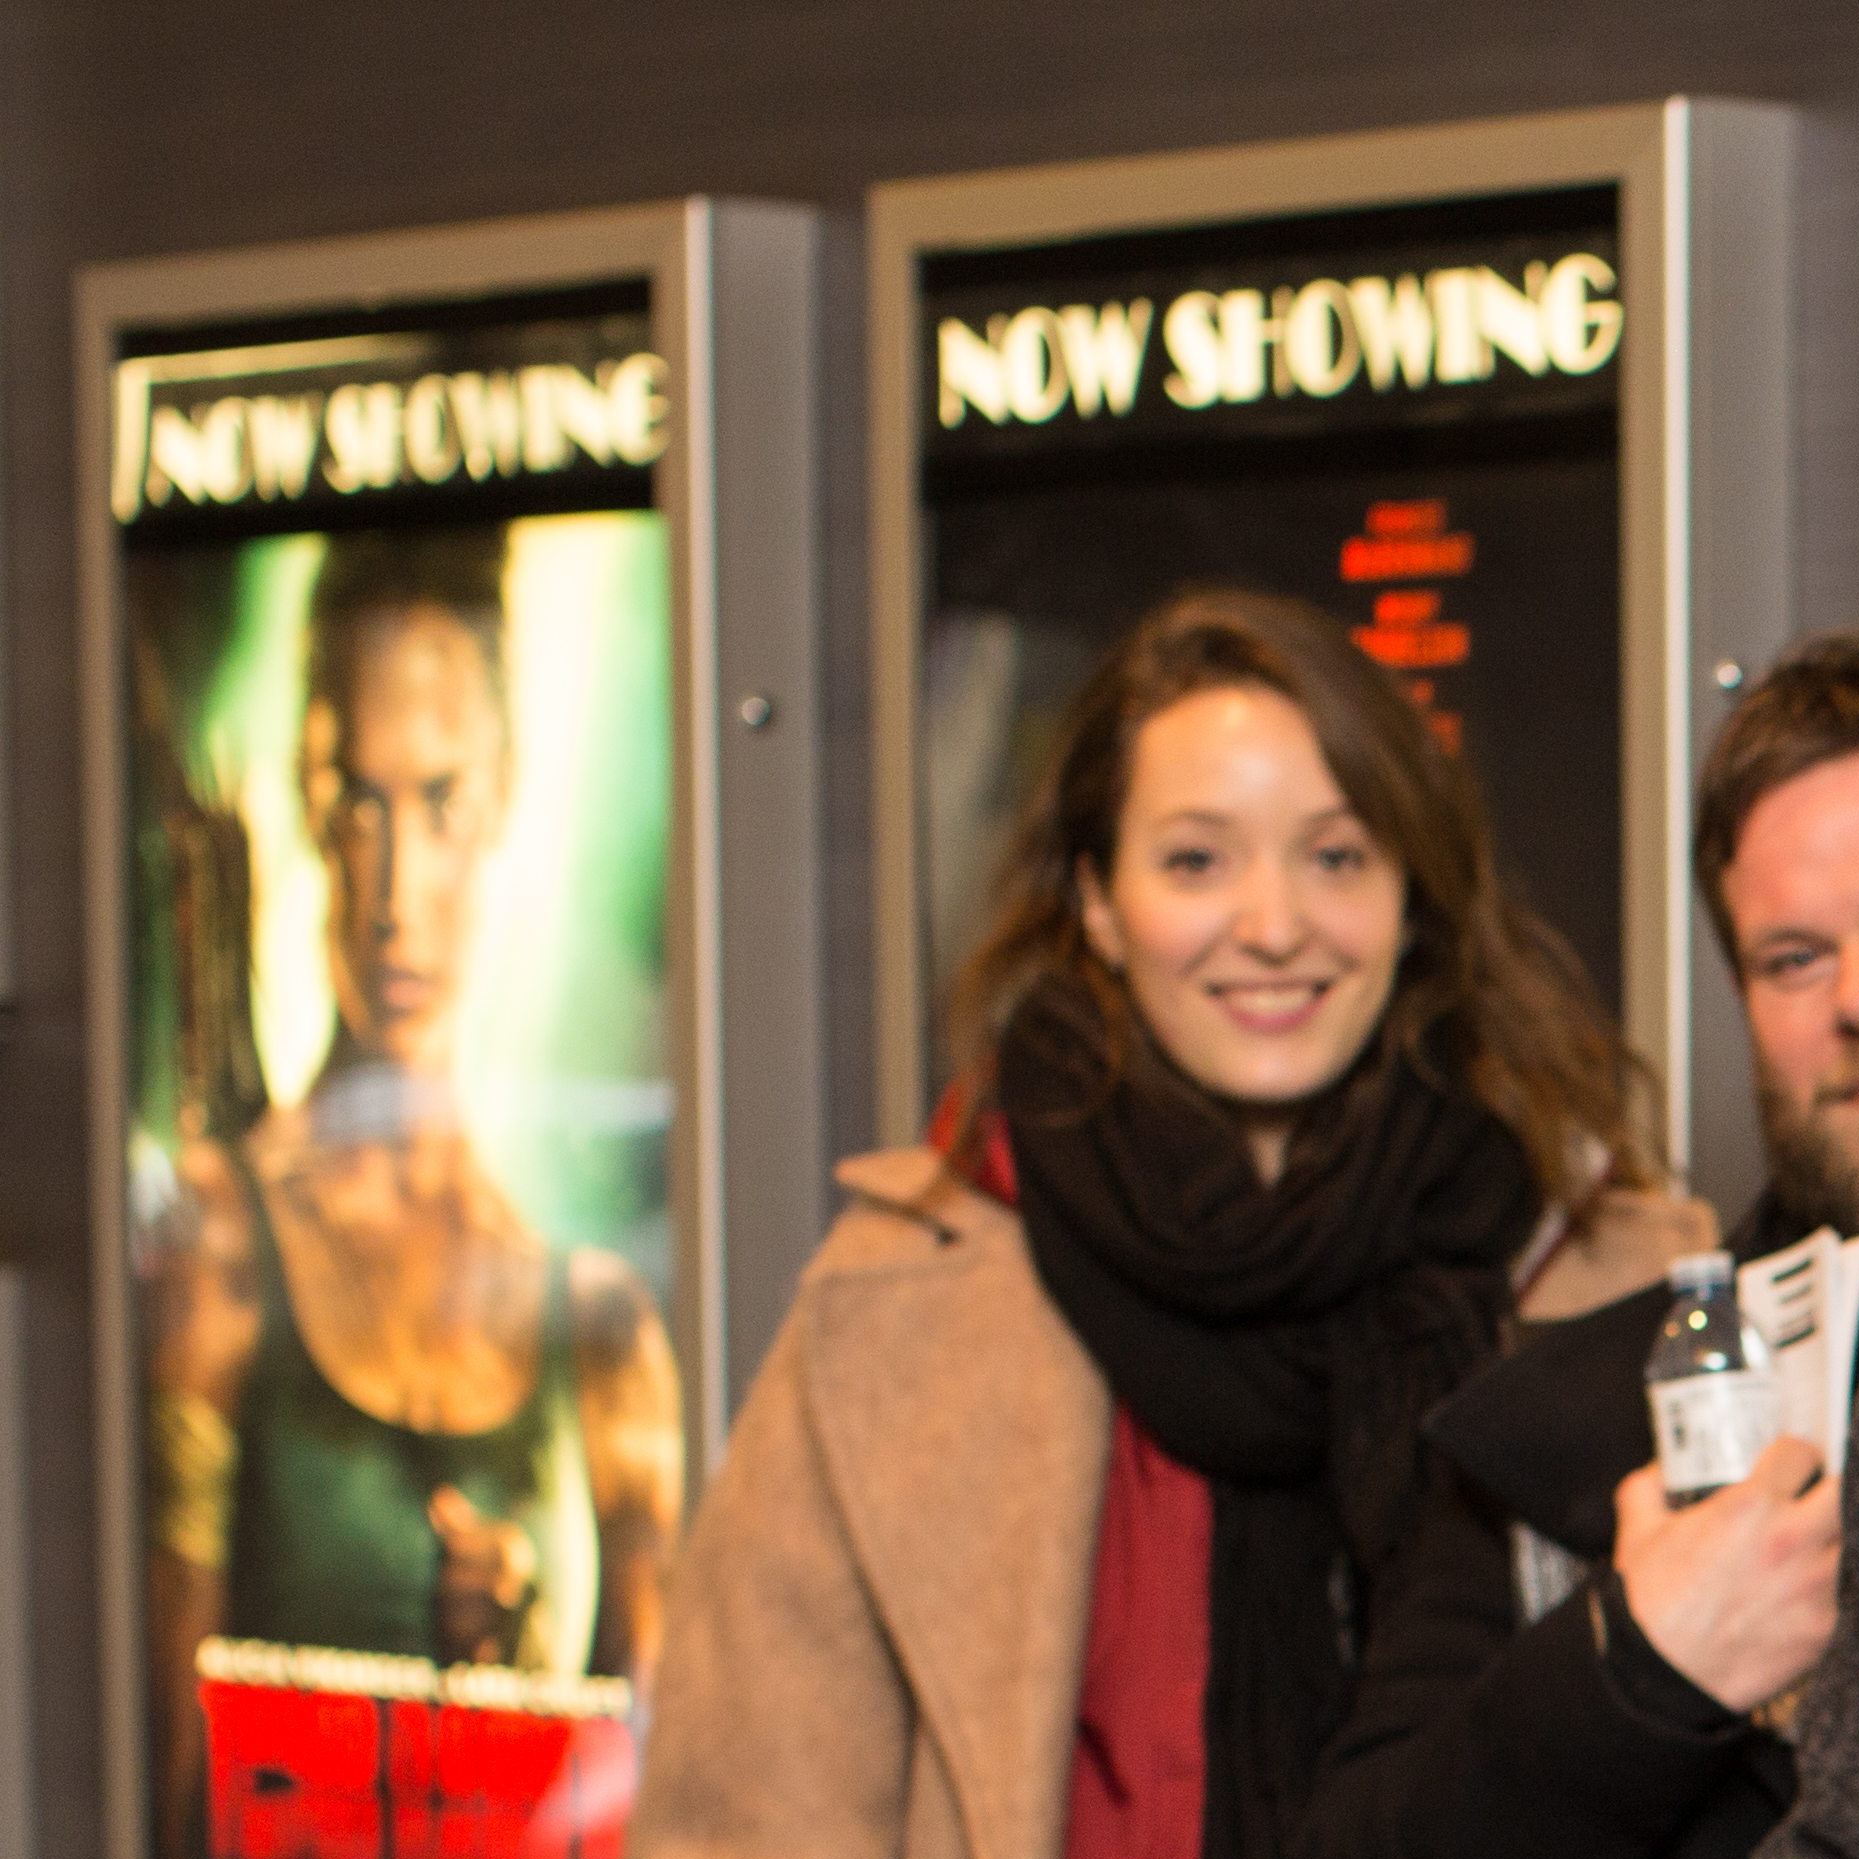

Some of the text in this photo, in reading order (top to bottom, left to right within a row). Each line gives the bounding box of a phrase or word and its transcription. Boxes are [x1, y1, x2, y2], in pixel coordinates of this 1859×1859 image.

[938, 252, 1624, 429] NOW SHOWING
[146, 351, 671, 507] NOW SHOWING
